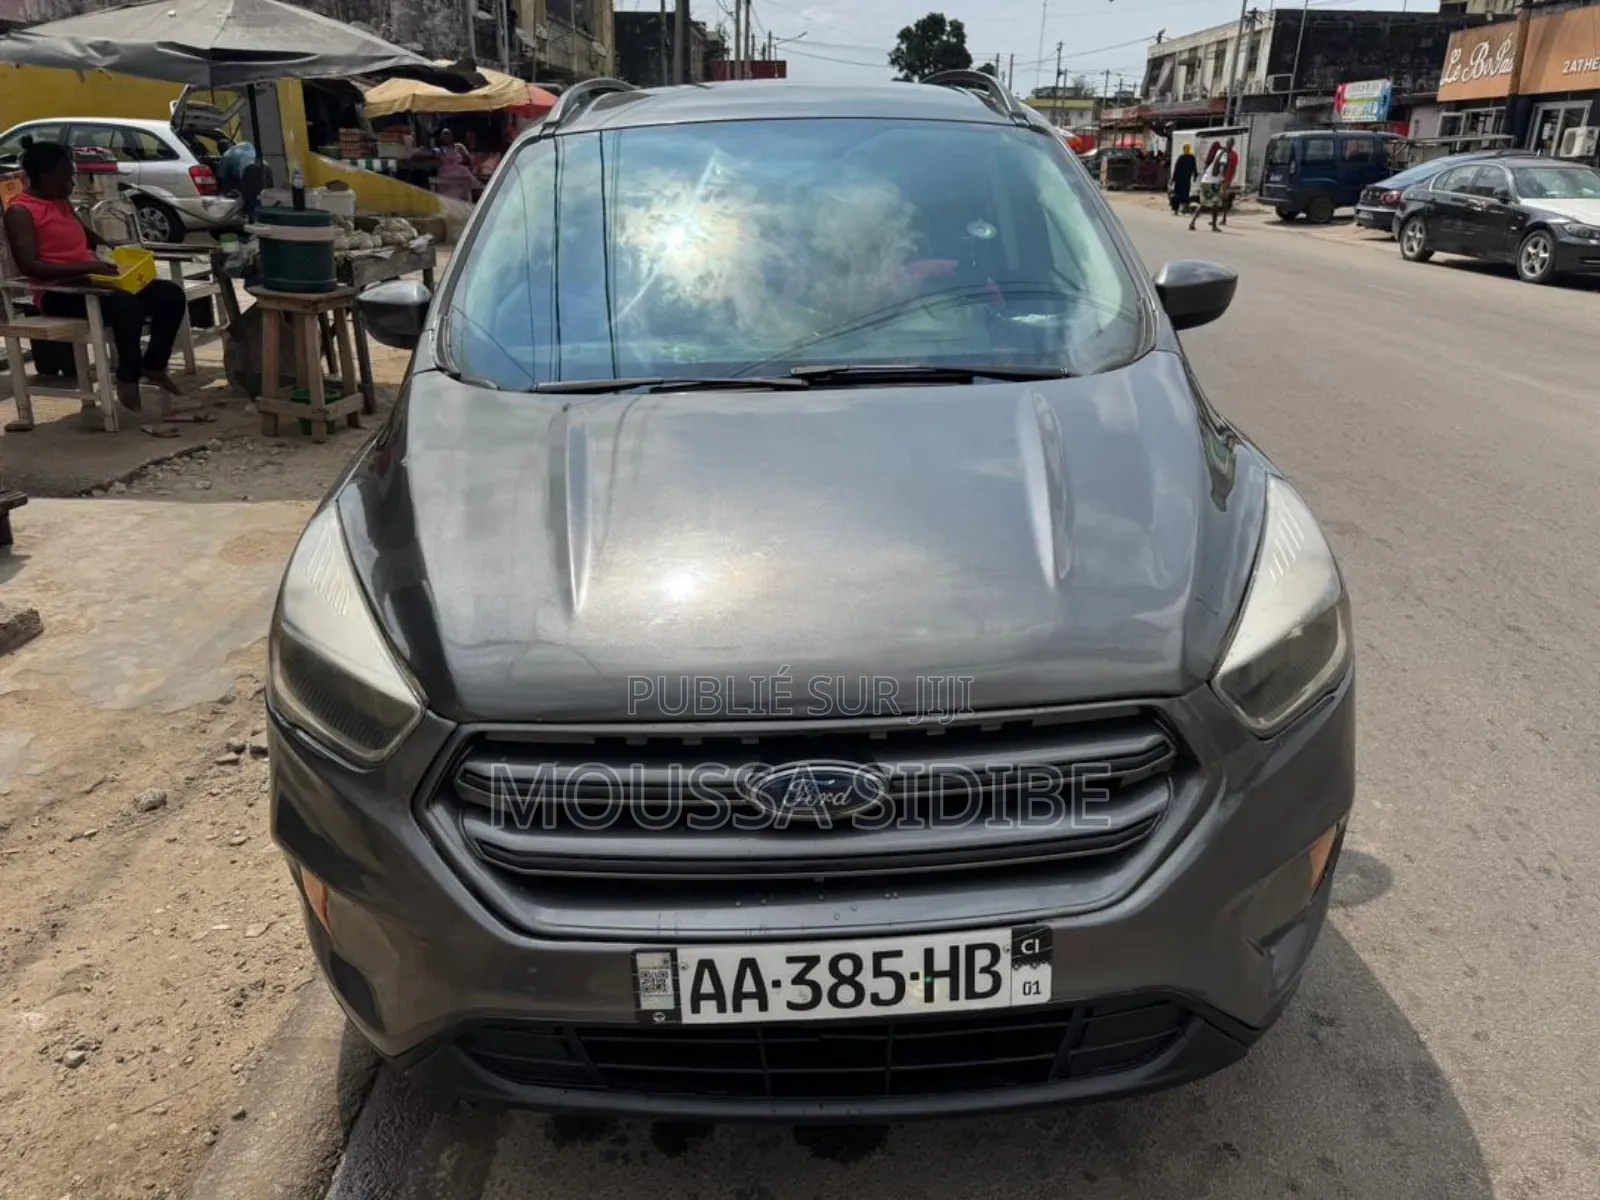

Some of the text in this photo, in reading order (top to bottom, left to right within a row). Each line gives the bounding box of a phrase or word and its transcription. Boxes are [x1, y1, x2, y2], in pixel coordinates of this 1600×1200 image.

[1562, 57, 1600, 73] 2ATHE
[784, 778, 852, 807] Ford
[1021, 939, 1040, 954] CI
[1023, 980, 1042, 996] 01
